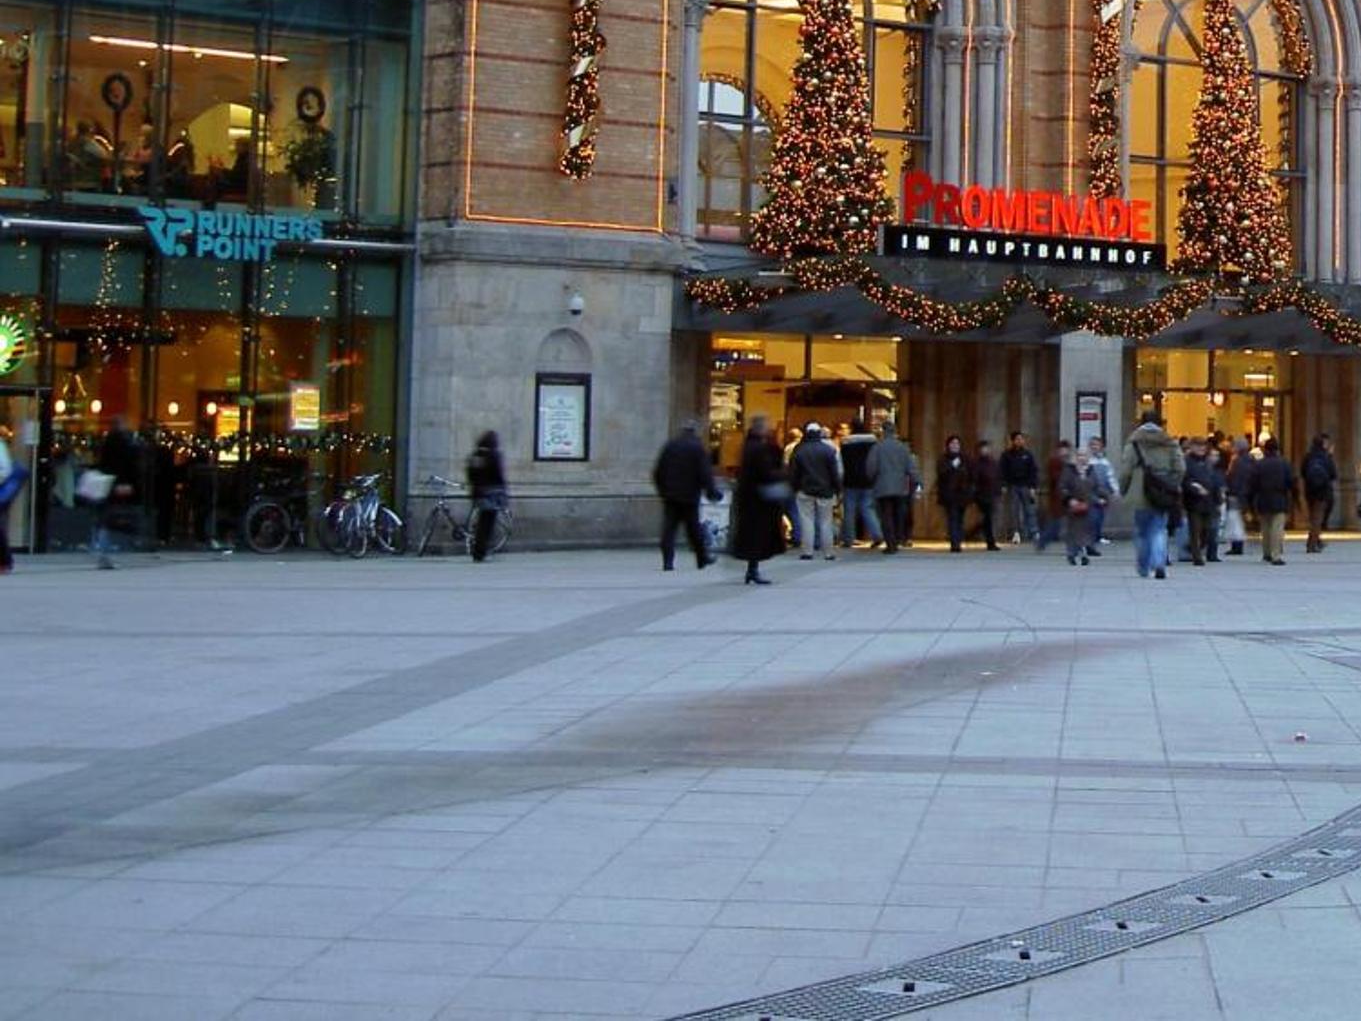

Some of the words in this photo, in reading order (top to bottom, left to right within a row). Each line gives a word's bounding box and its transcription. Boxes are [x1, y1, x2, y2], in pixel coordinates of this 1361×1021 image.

[903, 168, 1154, 242] PROMENADE
[198, 210, 322, 240] RUNNERS
[196, 235, 276, 261] POINT
[902, 234, 930, 250] IM
[949, 238, 1153, 264] HAUPTBAHNHOF
